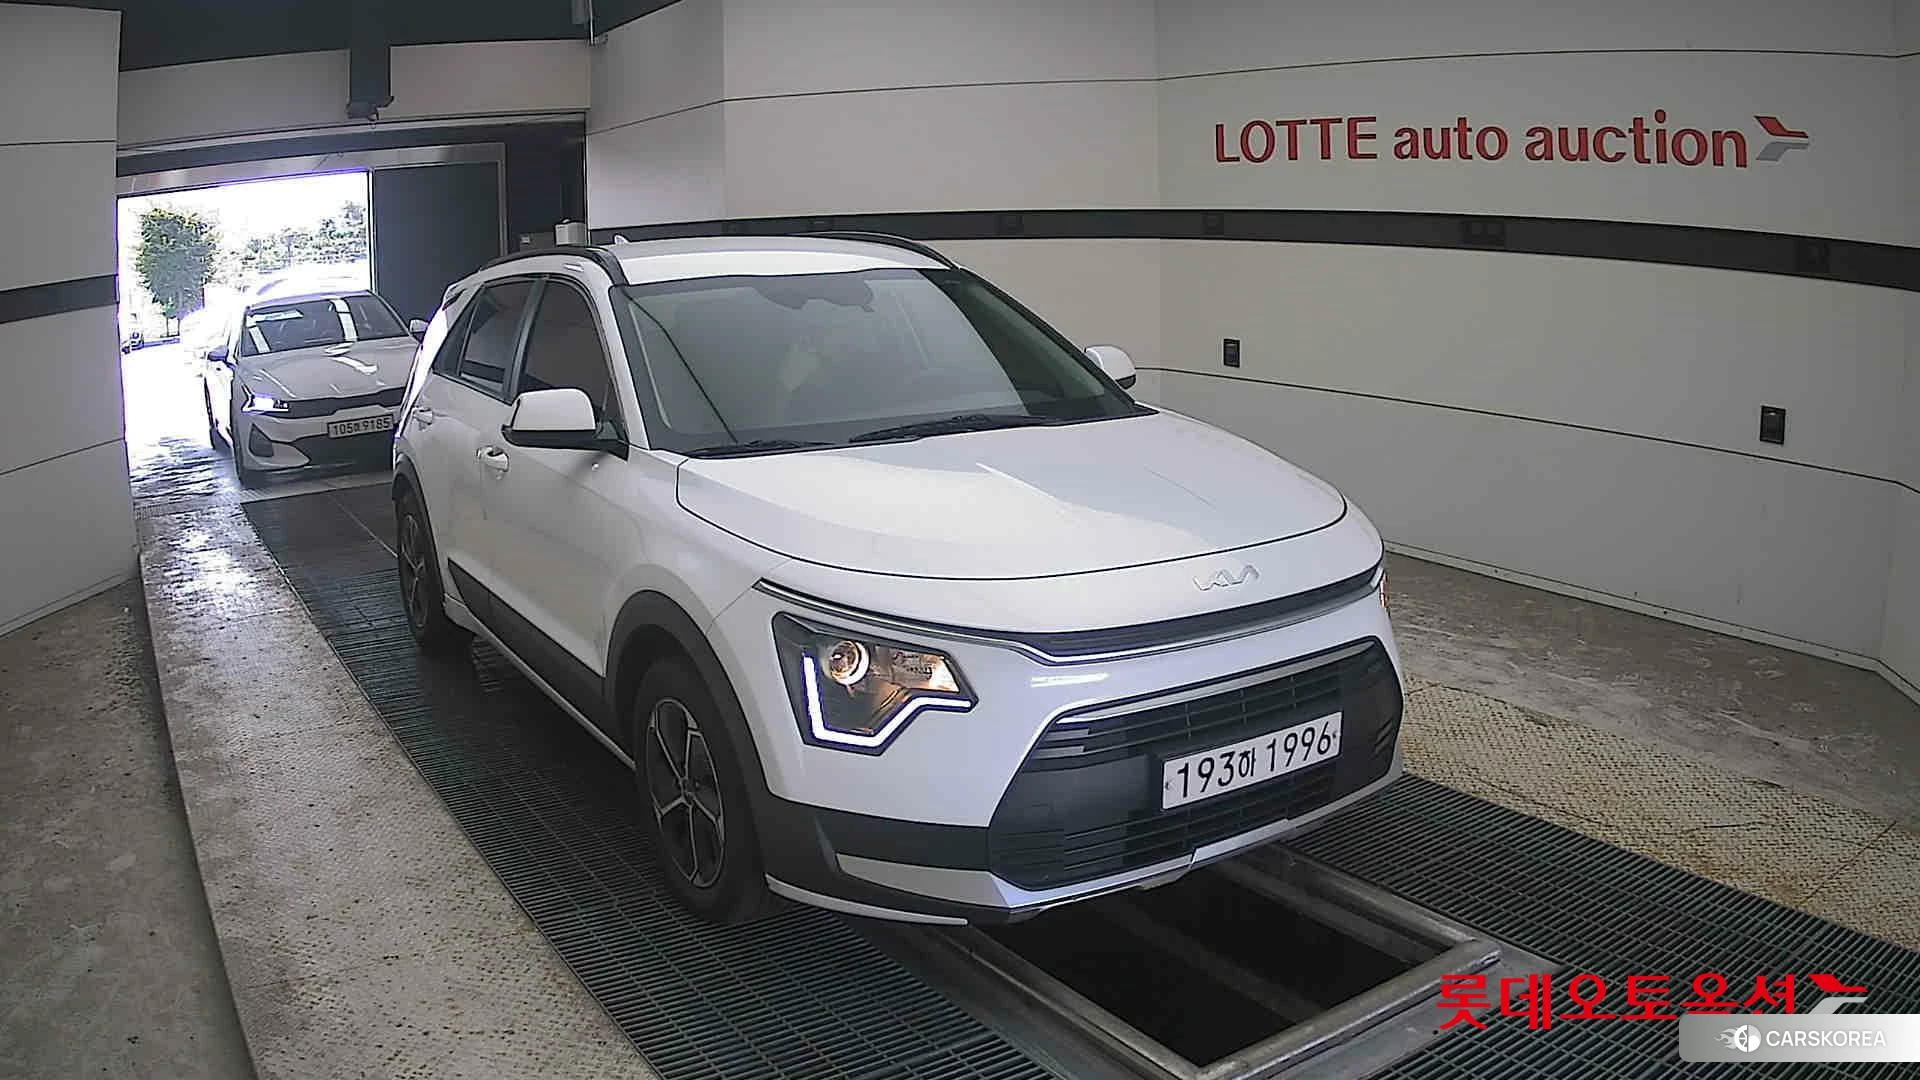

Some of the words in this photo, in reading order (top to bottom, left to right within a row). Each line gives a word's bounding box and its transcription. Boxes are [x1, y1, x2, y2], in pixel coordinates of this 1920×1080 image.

[1215, 116, 1378, 163] LOTTE
[1393, 116, 1509, 161] auto
[1524, 109, 1748, 168] auction
[1177, 747, 1257, 799] 193하
[1267, 721, 1332, 772] 1996
